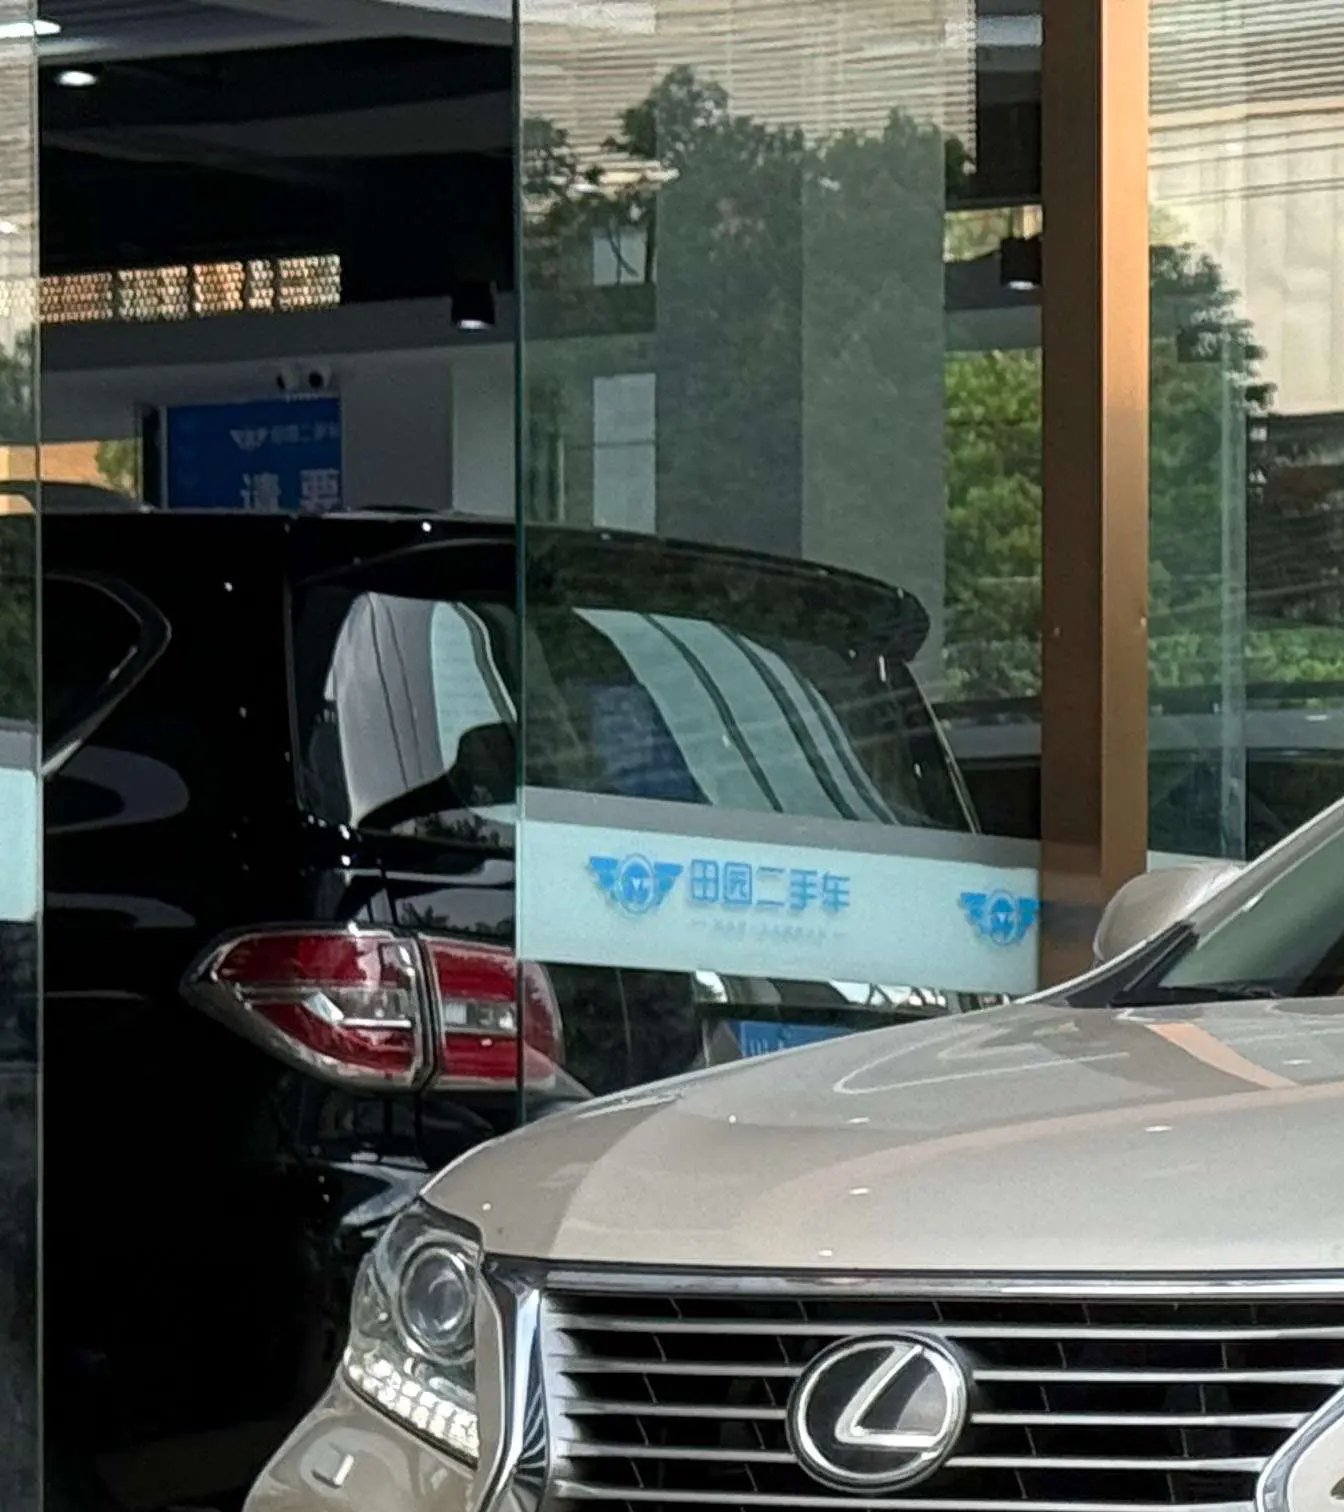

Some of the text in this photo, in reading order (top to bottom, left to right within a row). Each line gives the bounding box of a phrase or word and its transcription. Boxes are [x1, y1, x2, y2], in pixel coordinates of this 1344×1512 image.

[690, 859, 850, 912] 田园二手车
